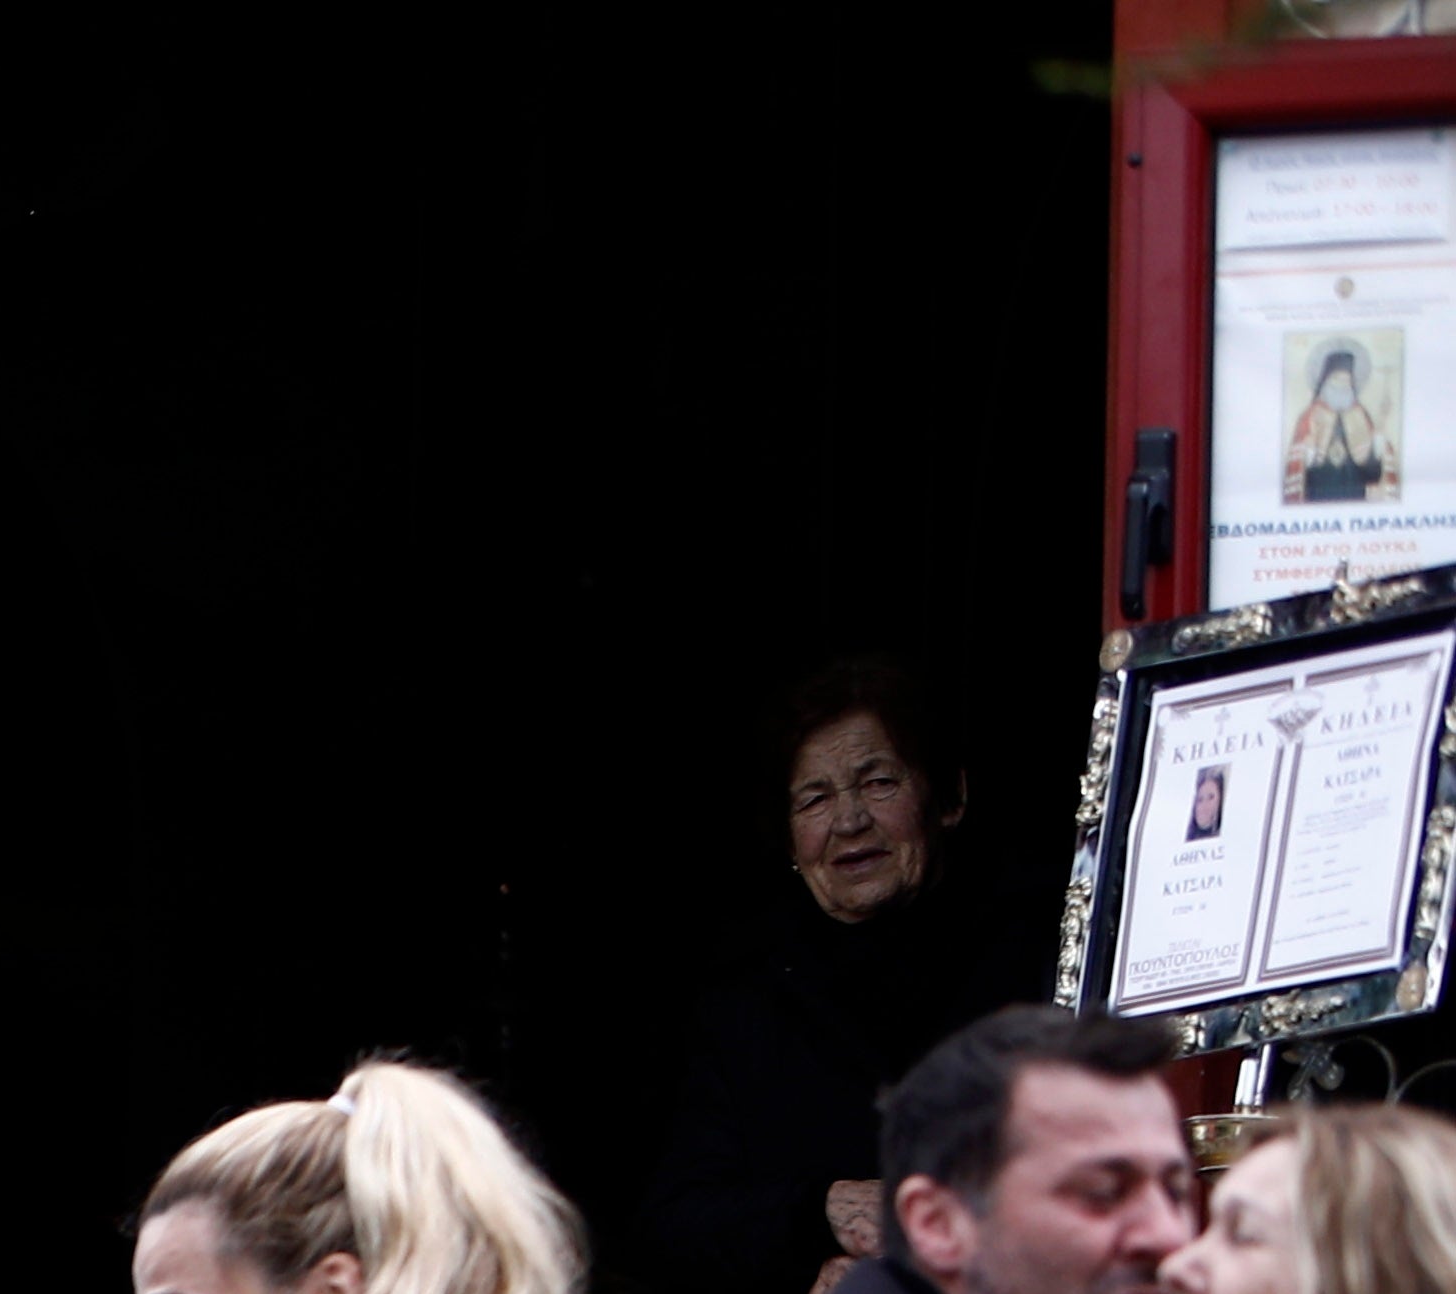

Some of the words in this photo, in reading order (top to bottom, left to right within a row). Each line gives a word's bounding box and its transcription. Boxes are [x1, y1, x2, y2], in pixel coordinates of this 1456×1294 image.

[1258, 545, 1306, 560] ΣΤΟΝ
[1312, 542, 1353, 557] ΑΓΙΟ
[1320, 701, 1413, 735] ΚΗΔΕΙΑ
[1172, 731, 1265, 765] ΚΗΔΕΙΑ
[1161, 874, 1224, 898] ΚΑΤΣΑΡΑ
